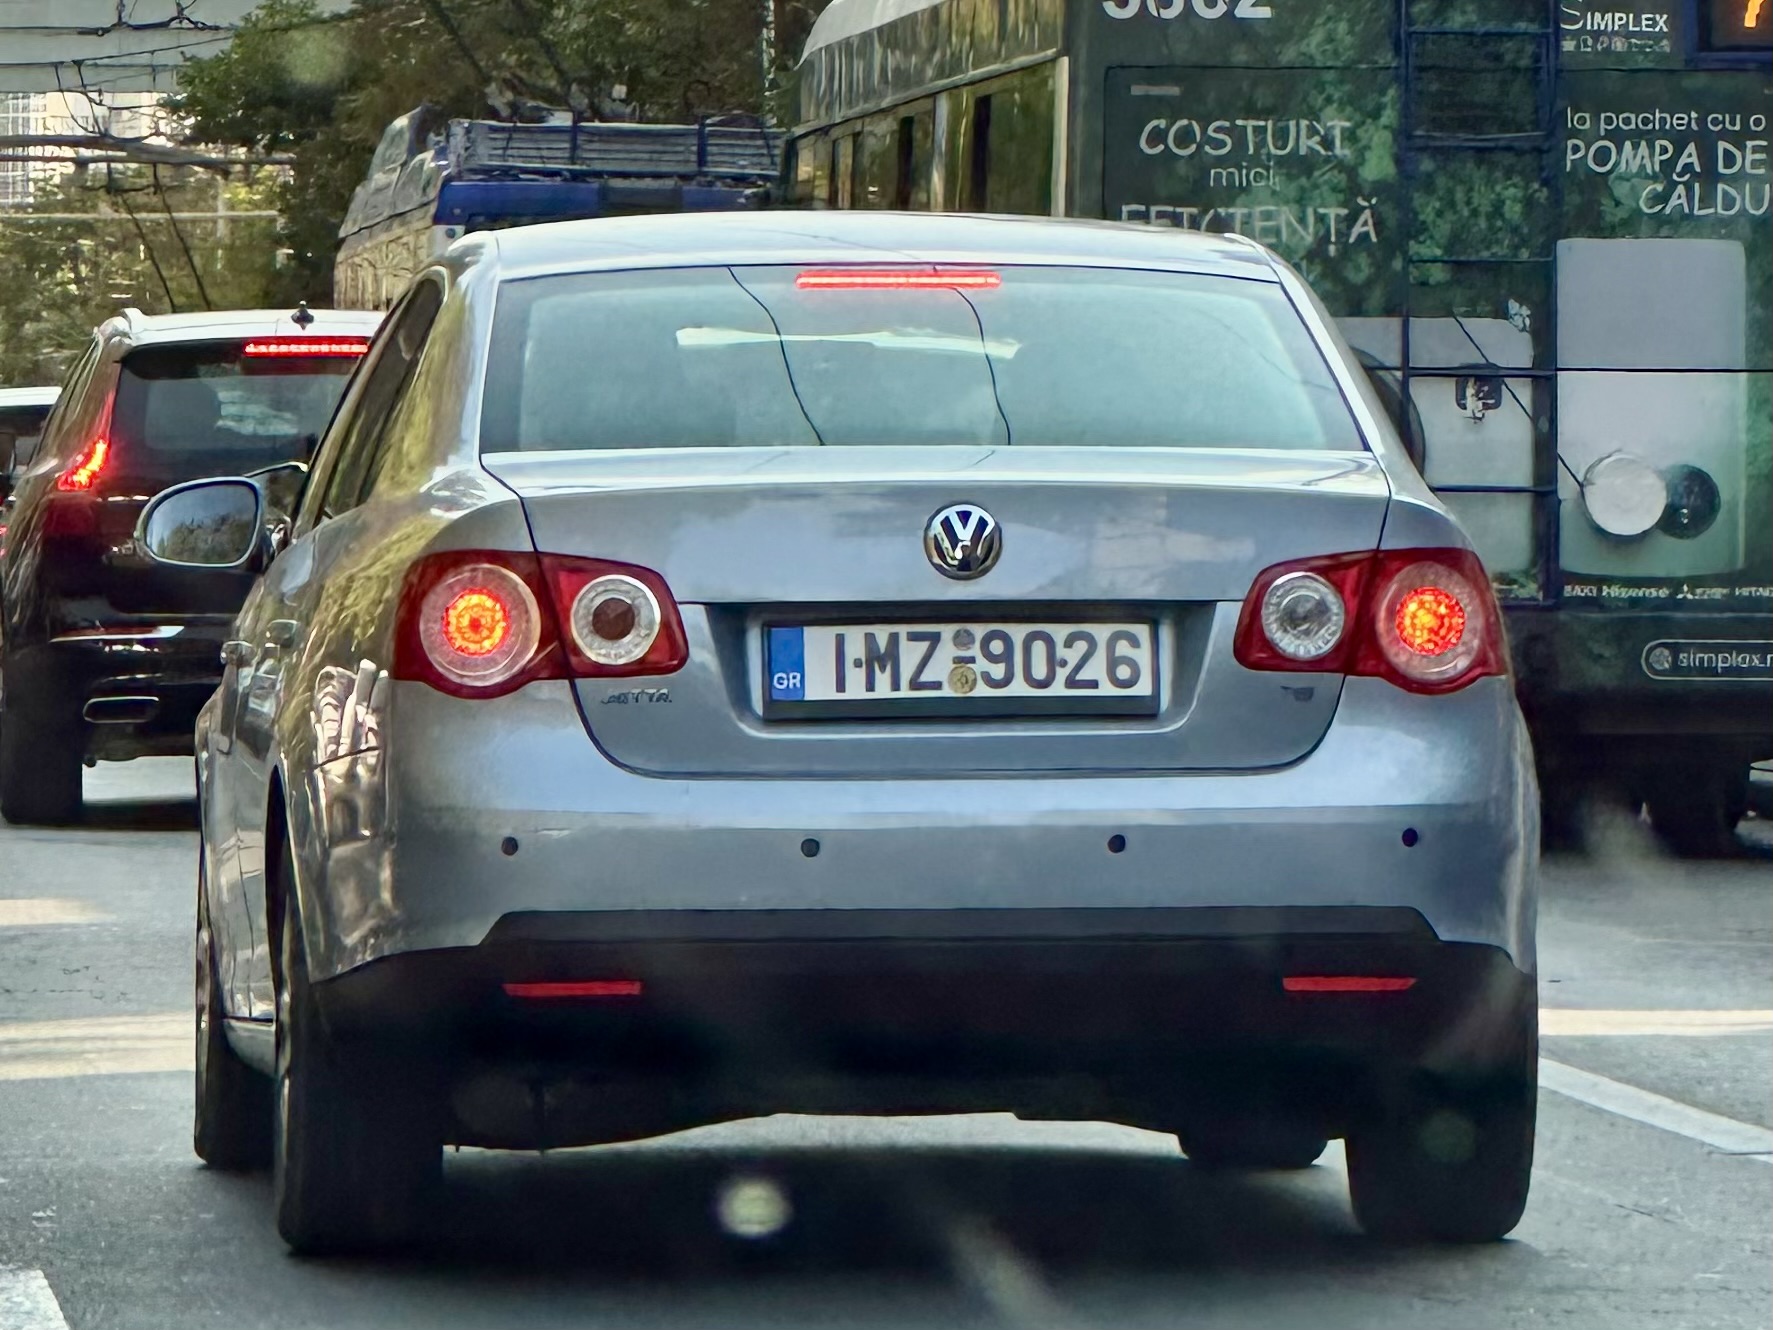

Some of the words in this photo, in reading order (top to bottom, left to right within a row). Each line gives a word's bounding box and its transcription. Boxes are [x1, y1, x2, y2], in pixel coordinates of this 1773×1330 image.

[1566, 107, 1591, 130] la
[1600, 108, 1699, 136] pachet
[1707, 113, 1742, 131] cu
[1749, 114, 1767, 131] o
[1717, 140, 1768, 175] DE
[773, 674, 801, 689] GR
